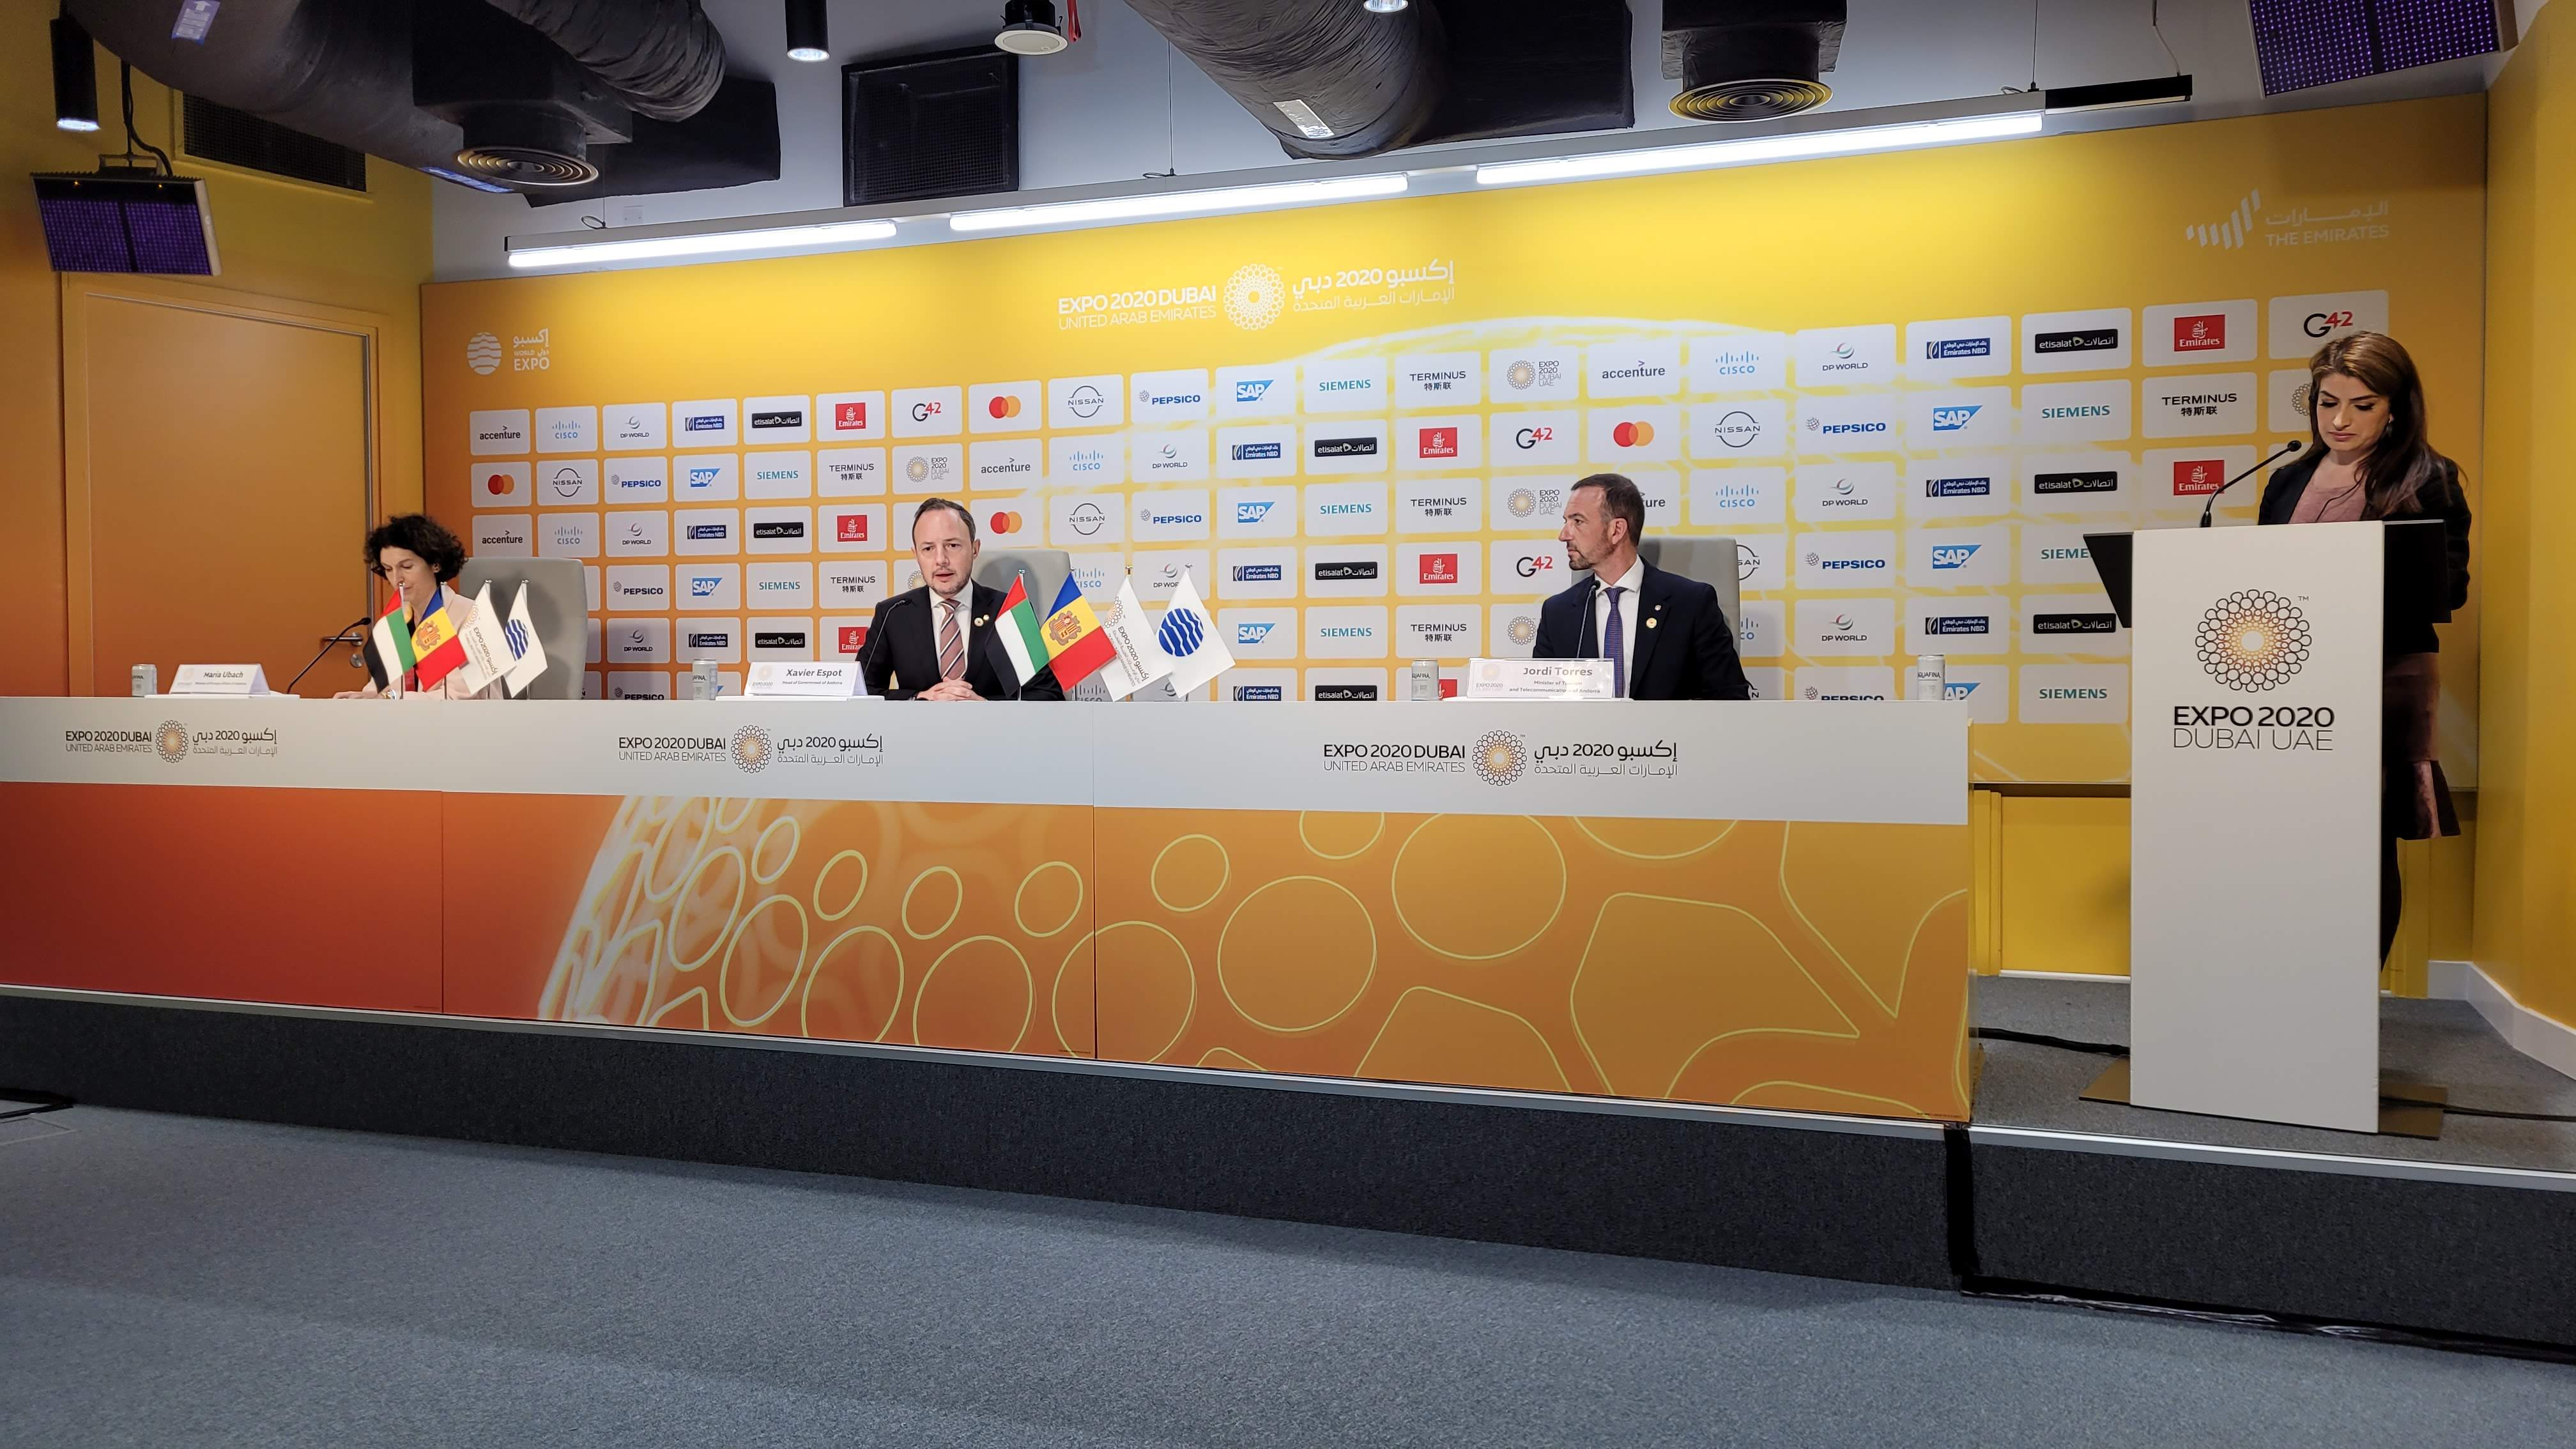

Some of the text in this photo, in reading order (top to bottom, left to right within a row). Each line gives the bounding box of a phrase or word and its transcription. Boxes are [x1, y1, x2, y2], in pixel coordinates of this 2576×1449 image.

[2266, 225, 2390, 246] THE EMIRATES
[1335, 268, 1383, 288] 2020
[1292, 275, 1332, 300] دبي
[1058, 286, 1216, 314] EXPO 2020 DUBAI
[1059, 305, 1216, 330] UNITED ARAB EMIRATES
[2304, 311, 2354, 338] G42
[2039, 339, 2073, 349] etisalat
[2179, 337, 2220, 348] Emirates
[1944, 346, 1987, 356] Emirates NBD
[514, 358, 549, 371] EXPO
[1719, 365, 1755, 374] CISCO
[1409, 371, 1466, 381] TERMINUS
[1602, 365, 1665, 379] accenture
[1320, 379, 1371, 391] SIEMENS
[1152, 395, 1200, 405] PEPSICO
[2162, 393, 2237, 405] TERMINUS
[2042, 405, 2110, 418] SIEMENS
[2181, 405, 2218, 417] 特斯联
[1934, 410, 1970, 427] SAP
[1823, 422, 1886, 434] PEPSICO
[479, 430, 521, 440] accenture
[1516, 427, 1552, 448] G42
[1423, 446, 1454, 454] Emirates
[829, 463, 874, 472] TERMINUS
[981, 462, 1031, 473] accenture
[1073, 463, 1100, 471] CISCO
[757, 470, 799, 480] SIEMENS
[2039, 481, 2071, 490] etisalat
[2179, 482, 2220, 491] Emirates
[1411, 497, 1467, 507] TERMINUS
[1720, 500, 1755, 508] CISCO
[1238, 505, 1266, 520] SAP
[1320, 504, 1372, 514] SIEMENS
[1153, 515, 1202, 524] PEPSICO
[482, 535, 523, 544] accenture
[1933, 549, 1969, 566] SAP
[2041, 548, 2090, 560] SIEME
[1822, 560, 1885, 569] PEPSICO
[1319, 568, 1343, 577] etisalat
[1423, 572, 1454, 581] Emirates
[759, 581, 800, 590] SIEMENS
[1411, 624, 1467, 632] TERMINUS
[2038, 620, 2070, 630] etisalat
[474, 627, 483, 643] EXPO
[1118, 626, 1138, 661] EXPO 2020
[816, 670, 842, 678] Espot
[1523, 667, 1593, 676] Jordi Torres
[1945, 687, 1968, 700] AP
[2039, 689, 2107, 699] SIEMENS
[2174, 706, 2334, 727] EXPO 2020
[66, 731, 152, 742] EXPO 2020 DUBAI
[215, 731, 240, 741] 2020
[2174, 728, 2333, 750] DUBAI UAE
[619, 737, 726, 749] EXPO 2020 DUBAI
[777, 738, 802, 753] دبي
[805, 737, 836, 747] 2020
[66, 744, 92, 753] UNITED
[93, 744, 115, 753] ARAB
[1324, 744, 1466, 759] EXPO 2020 DUBAI
[1535, 745, 1568, 763] دبي
[1573, 744, 1614, 758] 2020
[619, 751, 726, 762] UNITED ARAB EMIRATES
[1324, 760, 1466, 773] UNITED ARAB EMIRATES
